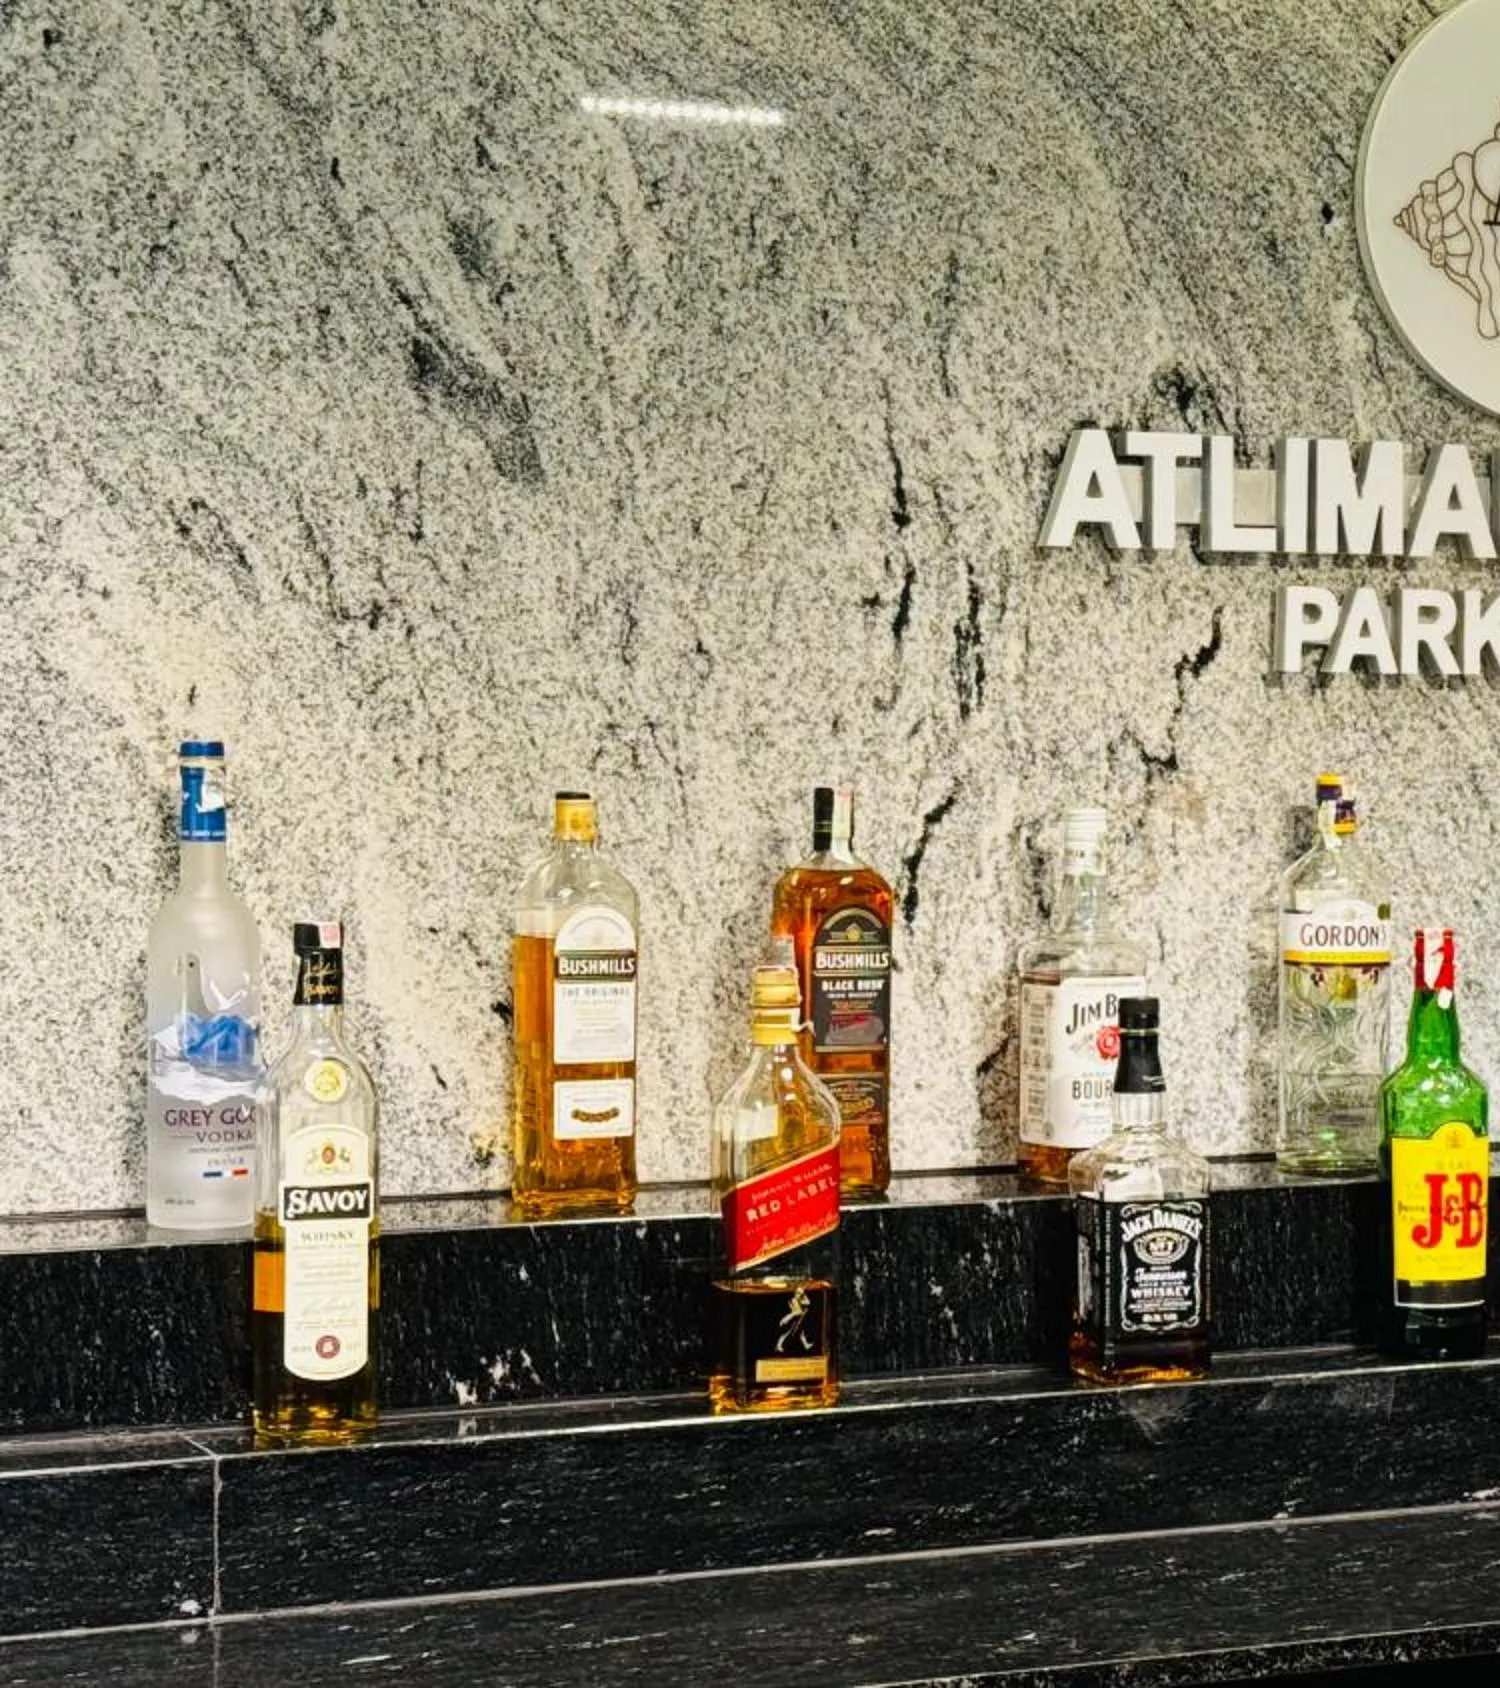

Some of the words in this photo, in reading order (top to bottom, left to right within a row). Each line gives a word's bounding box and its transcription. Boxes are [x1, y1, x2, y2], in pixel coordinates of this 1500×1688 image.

[558, 957, 635, 975] BUSHMILLS
[814, 951, 890, 969] BUSHMILLS
[821, 979, 854, 991] BLACK
[1071, 1079, 1114, 1100] BOUR
[163, 1108, 213, 1128] GREY
[195, 1129, 253, 1143] VODKA
[286, 1188, 369, 1219] SAVOY
[745, 1199, 781, 1223] RED
[785, 1175, 838, 1207] LABEL
[1411, 1171, 1484, 1250] J&B
[1129, 1284, 1191, 1299] WHISKEY
